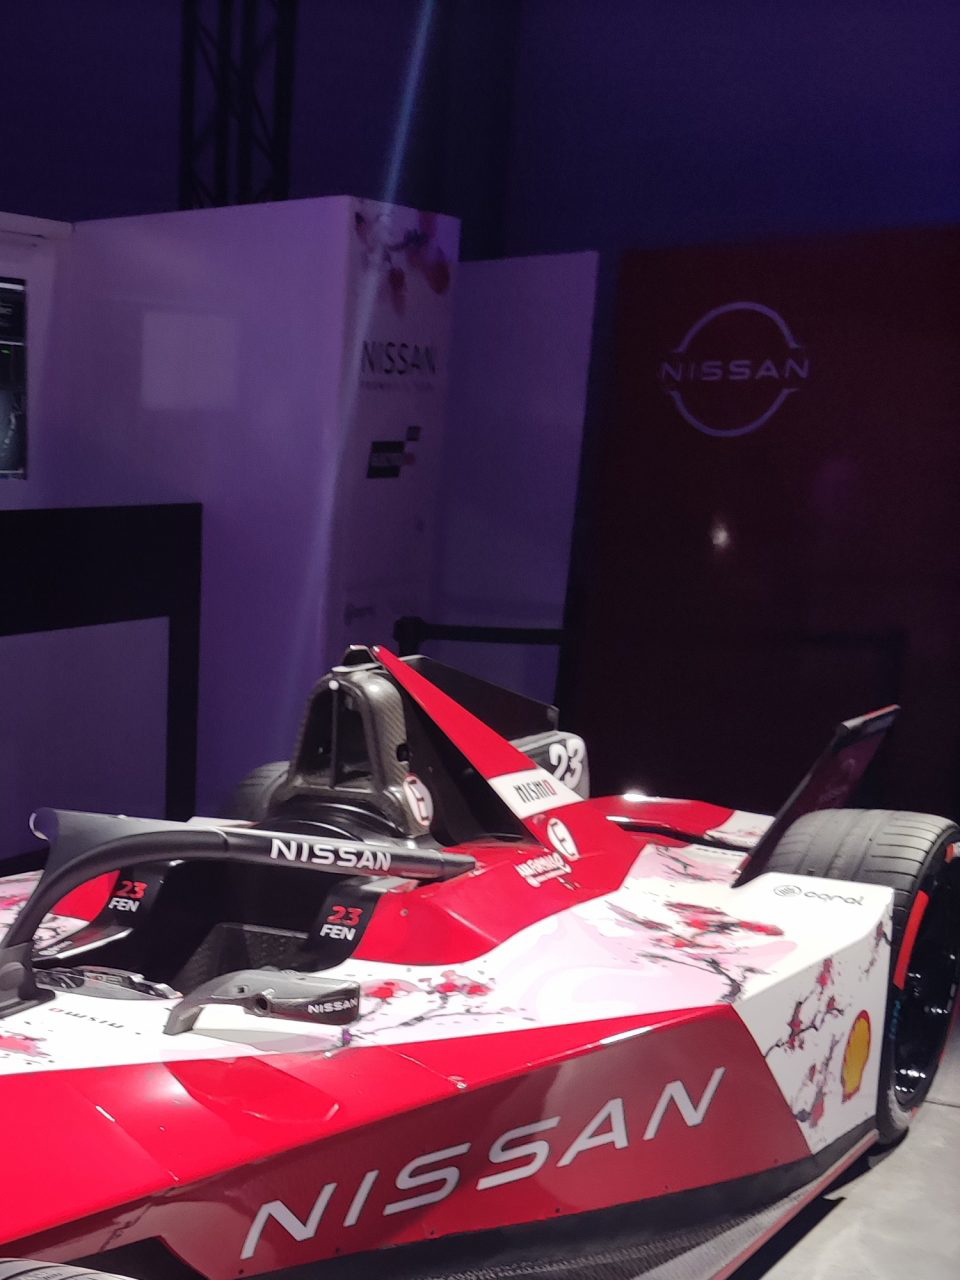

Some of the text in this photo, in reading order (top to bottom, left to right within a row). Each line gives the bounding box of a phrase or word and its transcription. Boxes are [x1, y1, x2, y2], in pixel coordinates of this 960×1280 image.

[360, 340, 436, 375] NISSAN
[658, 358, 810, 382] NISSAN
[549, 738, 585, 790] 23
[270, 838, 391, 872] NISSAN
[116, 880, 148, 899] 23
[108, 898, 140, 912] FEN
[327, 905, 364, 926] 23
[320, 924, 356, 941] FEN
[307, 996, 359, 1014] NISSAN
[240, 1066, 726, 1260] NISSAN
